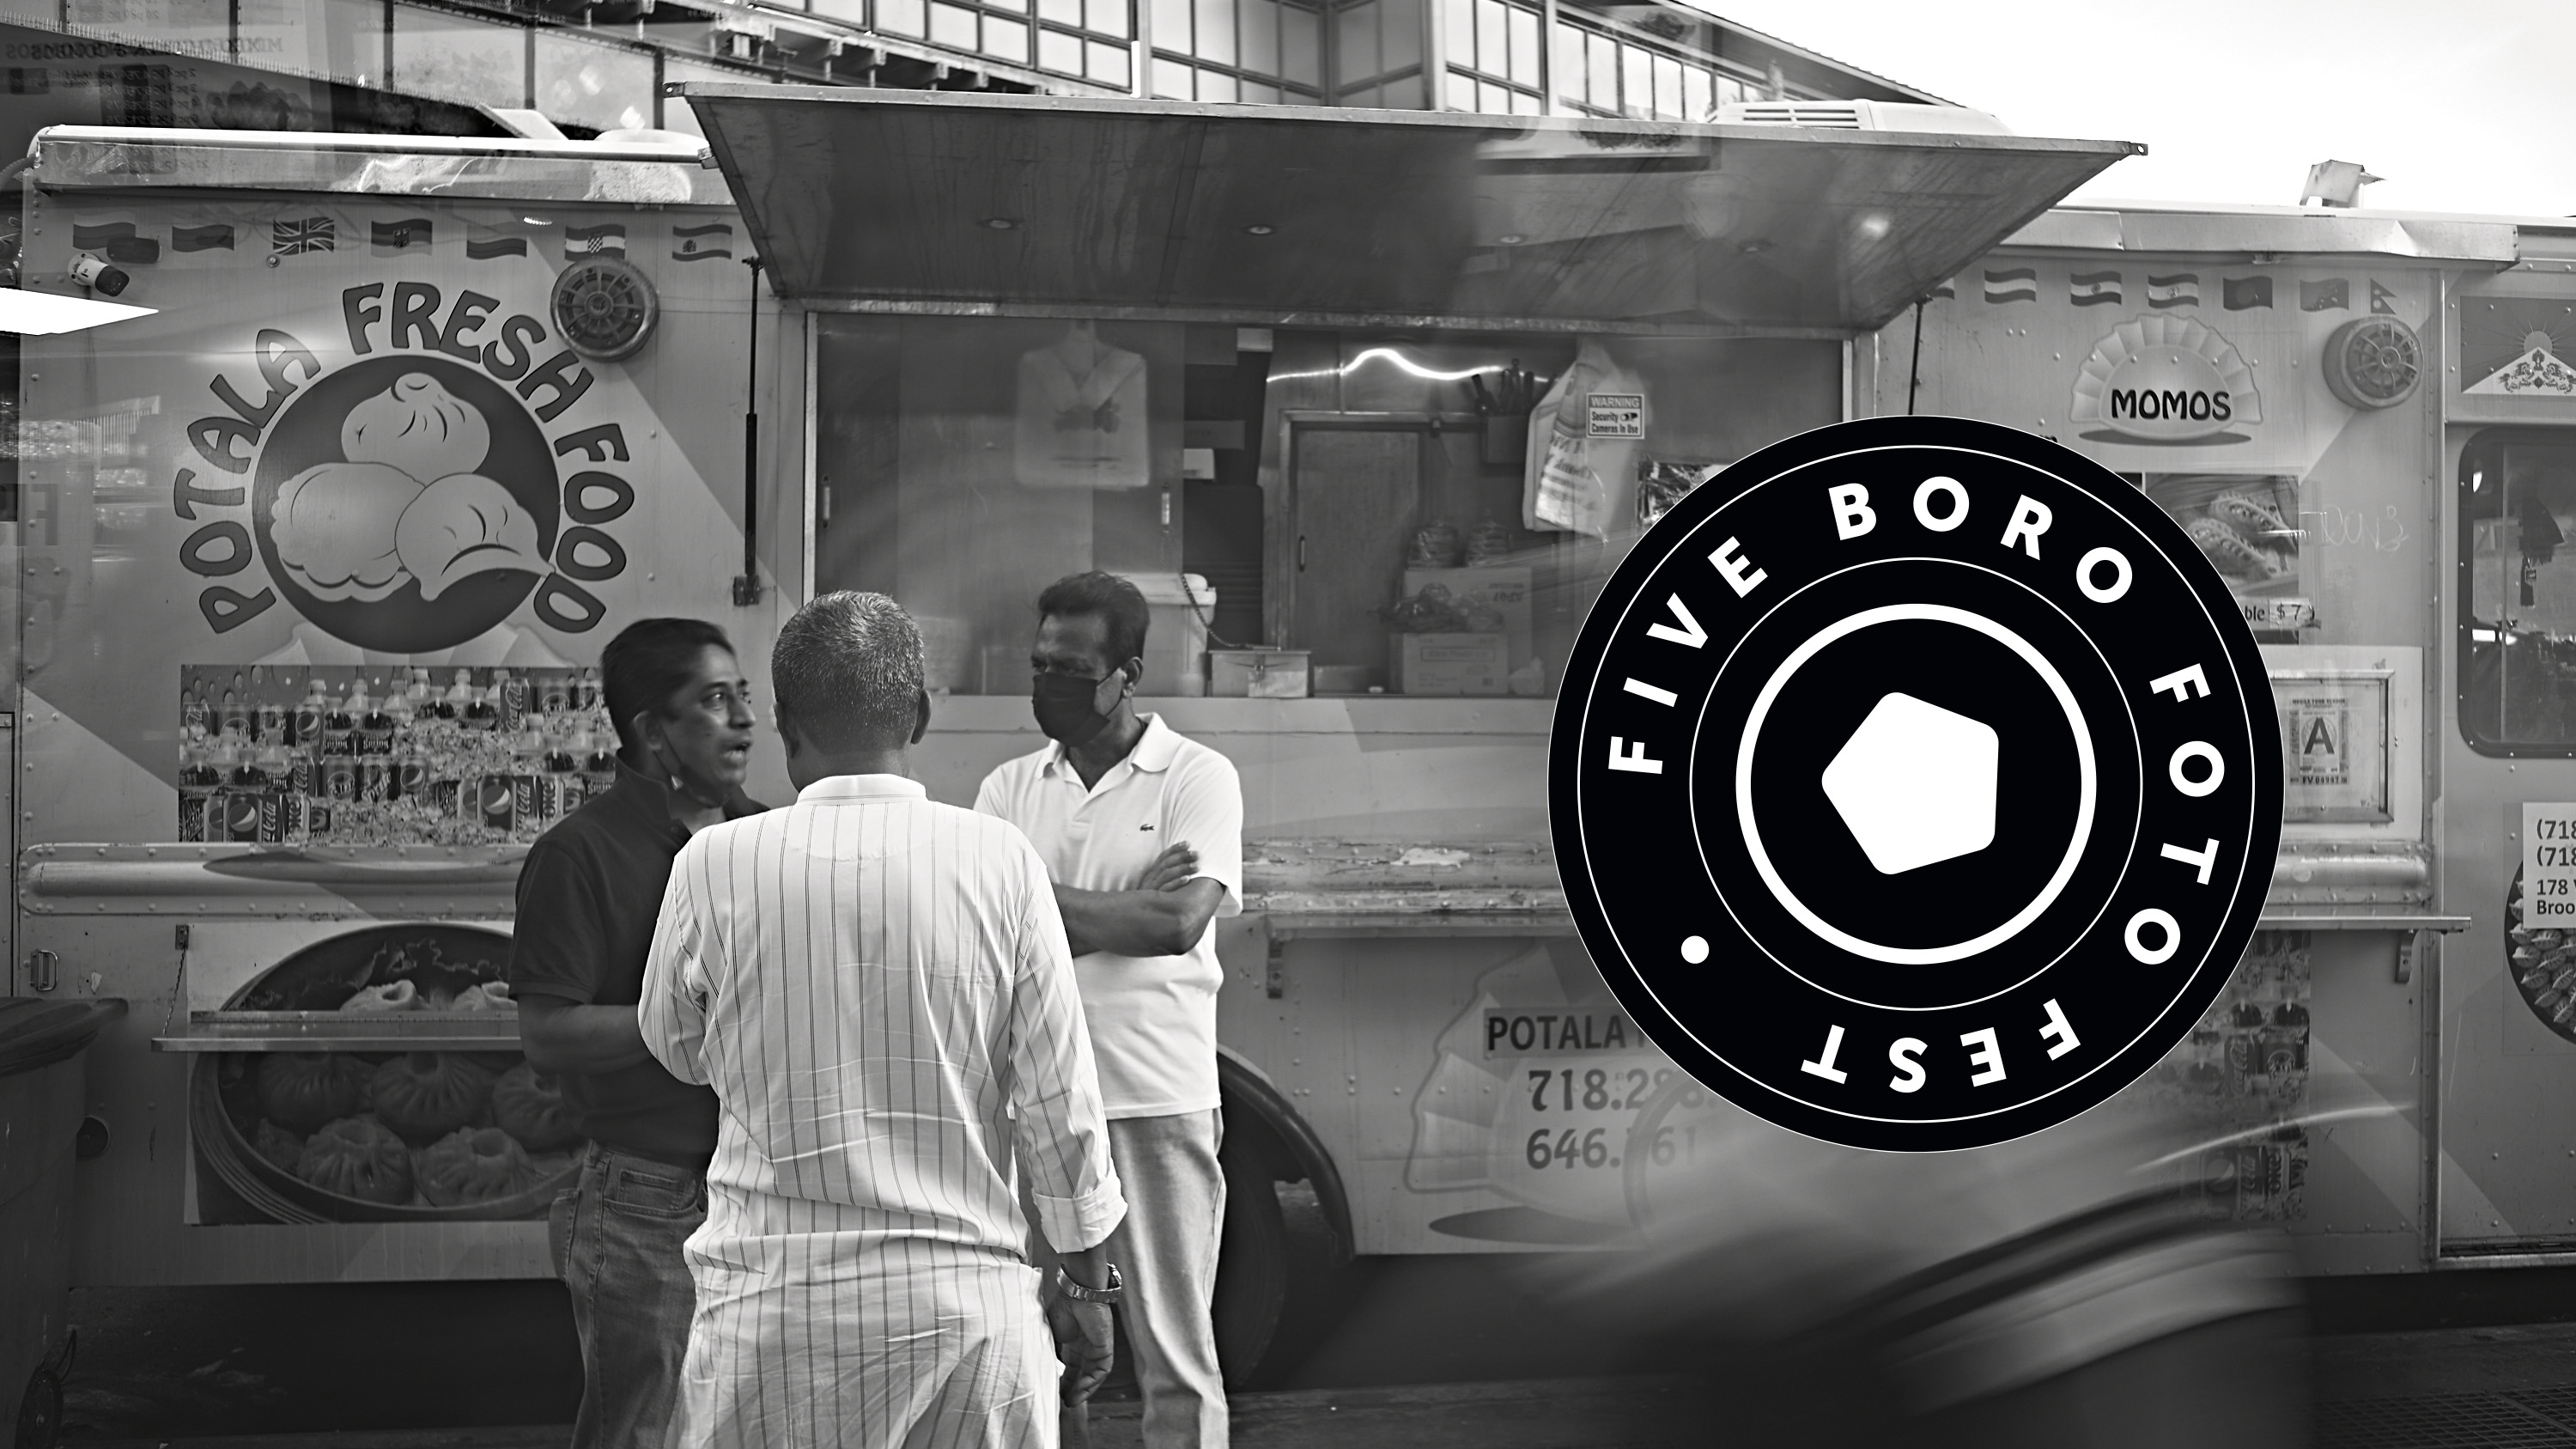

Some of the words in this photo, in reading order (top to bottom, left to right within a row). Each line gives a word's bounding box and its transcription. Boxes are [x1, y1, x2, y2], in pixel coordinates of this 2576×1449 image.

[1590, 396, 1640, 408] WARNING
[2110, 388, 2233, 422] MOMOS
[1592, 411, 1619, 423] Security
[1592, 423, 1619, 434] Cameras
[1619, 423, 1626, 434] In
[1627, 423, 1639, 434] Use
[173, 328, 321, 634] POTALA
[343, 281, 595, 423] FRESH
[534, 423, 635, 634] FOOD
[2304, 716, 2335, 754] A
[2537, 879, 2568, 897] 178
[1487, 1015, 1627, 1051] POTALA
